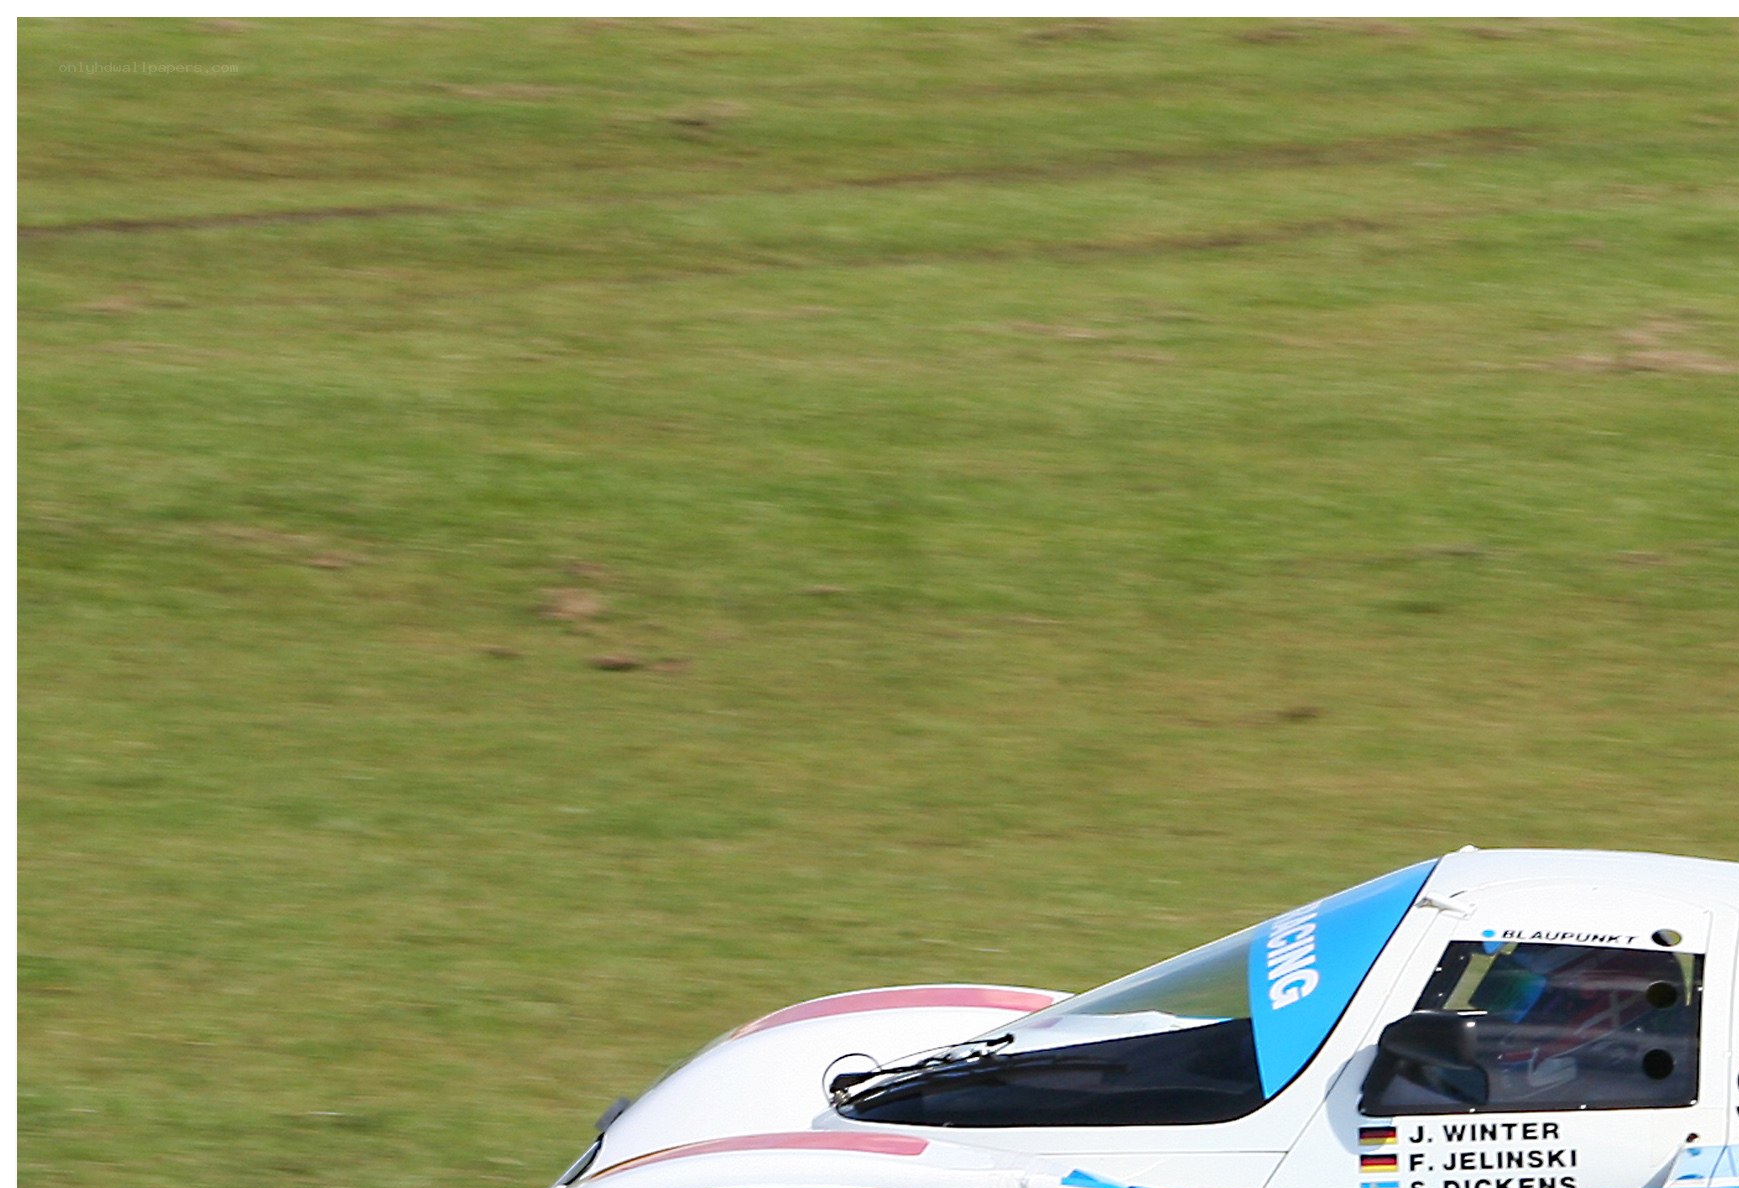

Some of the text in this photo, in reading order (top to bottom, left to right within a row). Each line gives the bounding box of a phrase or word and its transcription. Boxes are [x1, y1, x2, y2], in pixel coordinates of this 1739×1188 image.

[1502, 929, 1639, 945] BLAUPUNKT
[1409, 1122, 1560, 1143] J. WINTER
[1409, 1150, 1578, 1171] F. JELINSKI
